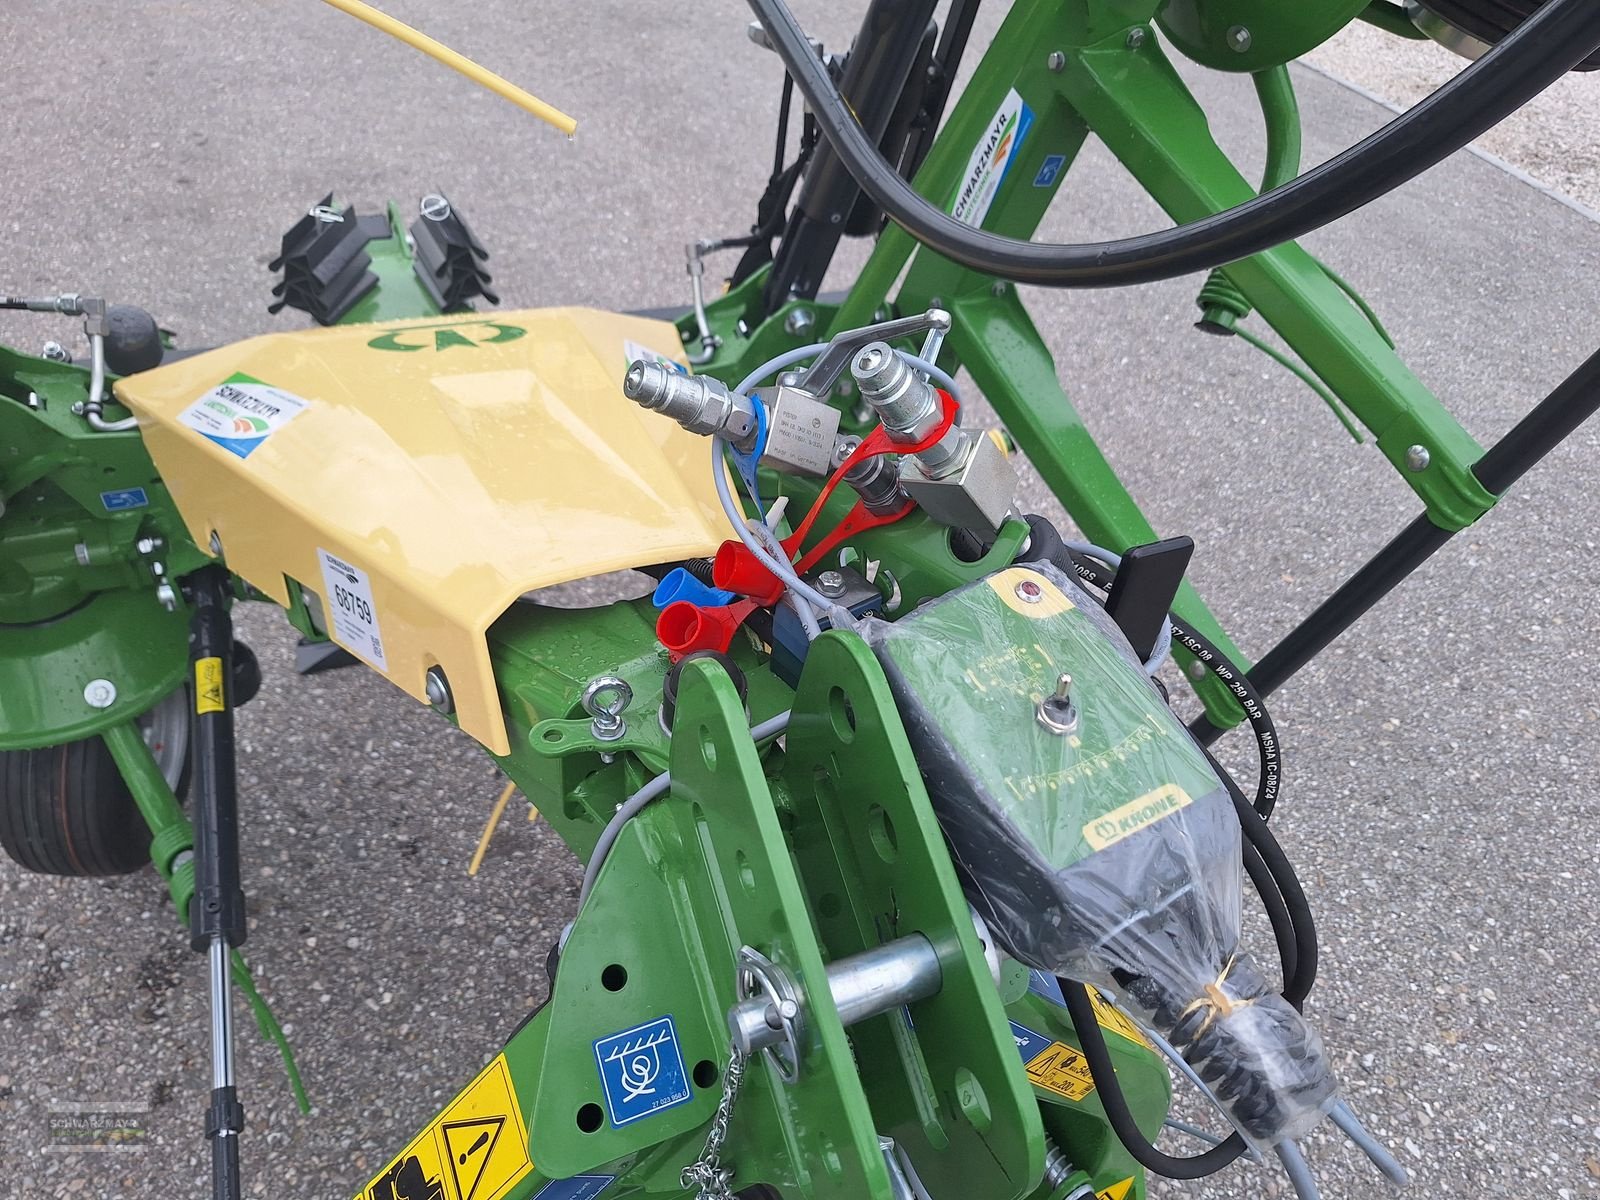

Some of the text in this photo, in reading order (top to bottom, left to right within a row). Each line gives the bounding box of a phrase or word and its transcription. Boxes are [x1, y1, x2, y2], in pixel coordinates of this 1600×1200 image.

[954, 113, 1007, 219] CHWARZMAYR
[335, 583, 372, 625] 68759
[1181, 636, 1201, 652] 1SC
[1198, 649, 1213, 661] 08
[1215, 664, 1233, 680] WP
[1230, 682, 1248, 698] 250
[1243, 698, 1262, 720] BAR
[1260, 731, 1276, 760] MSHA
[1265, 761, 1278, 800] IC-08/24
[1120, 794, 1179, 833] KRONE
[1058, 1080, 1075, 1092] 200
[651, 1100, 659, 1108] 27
